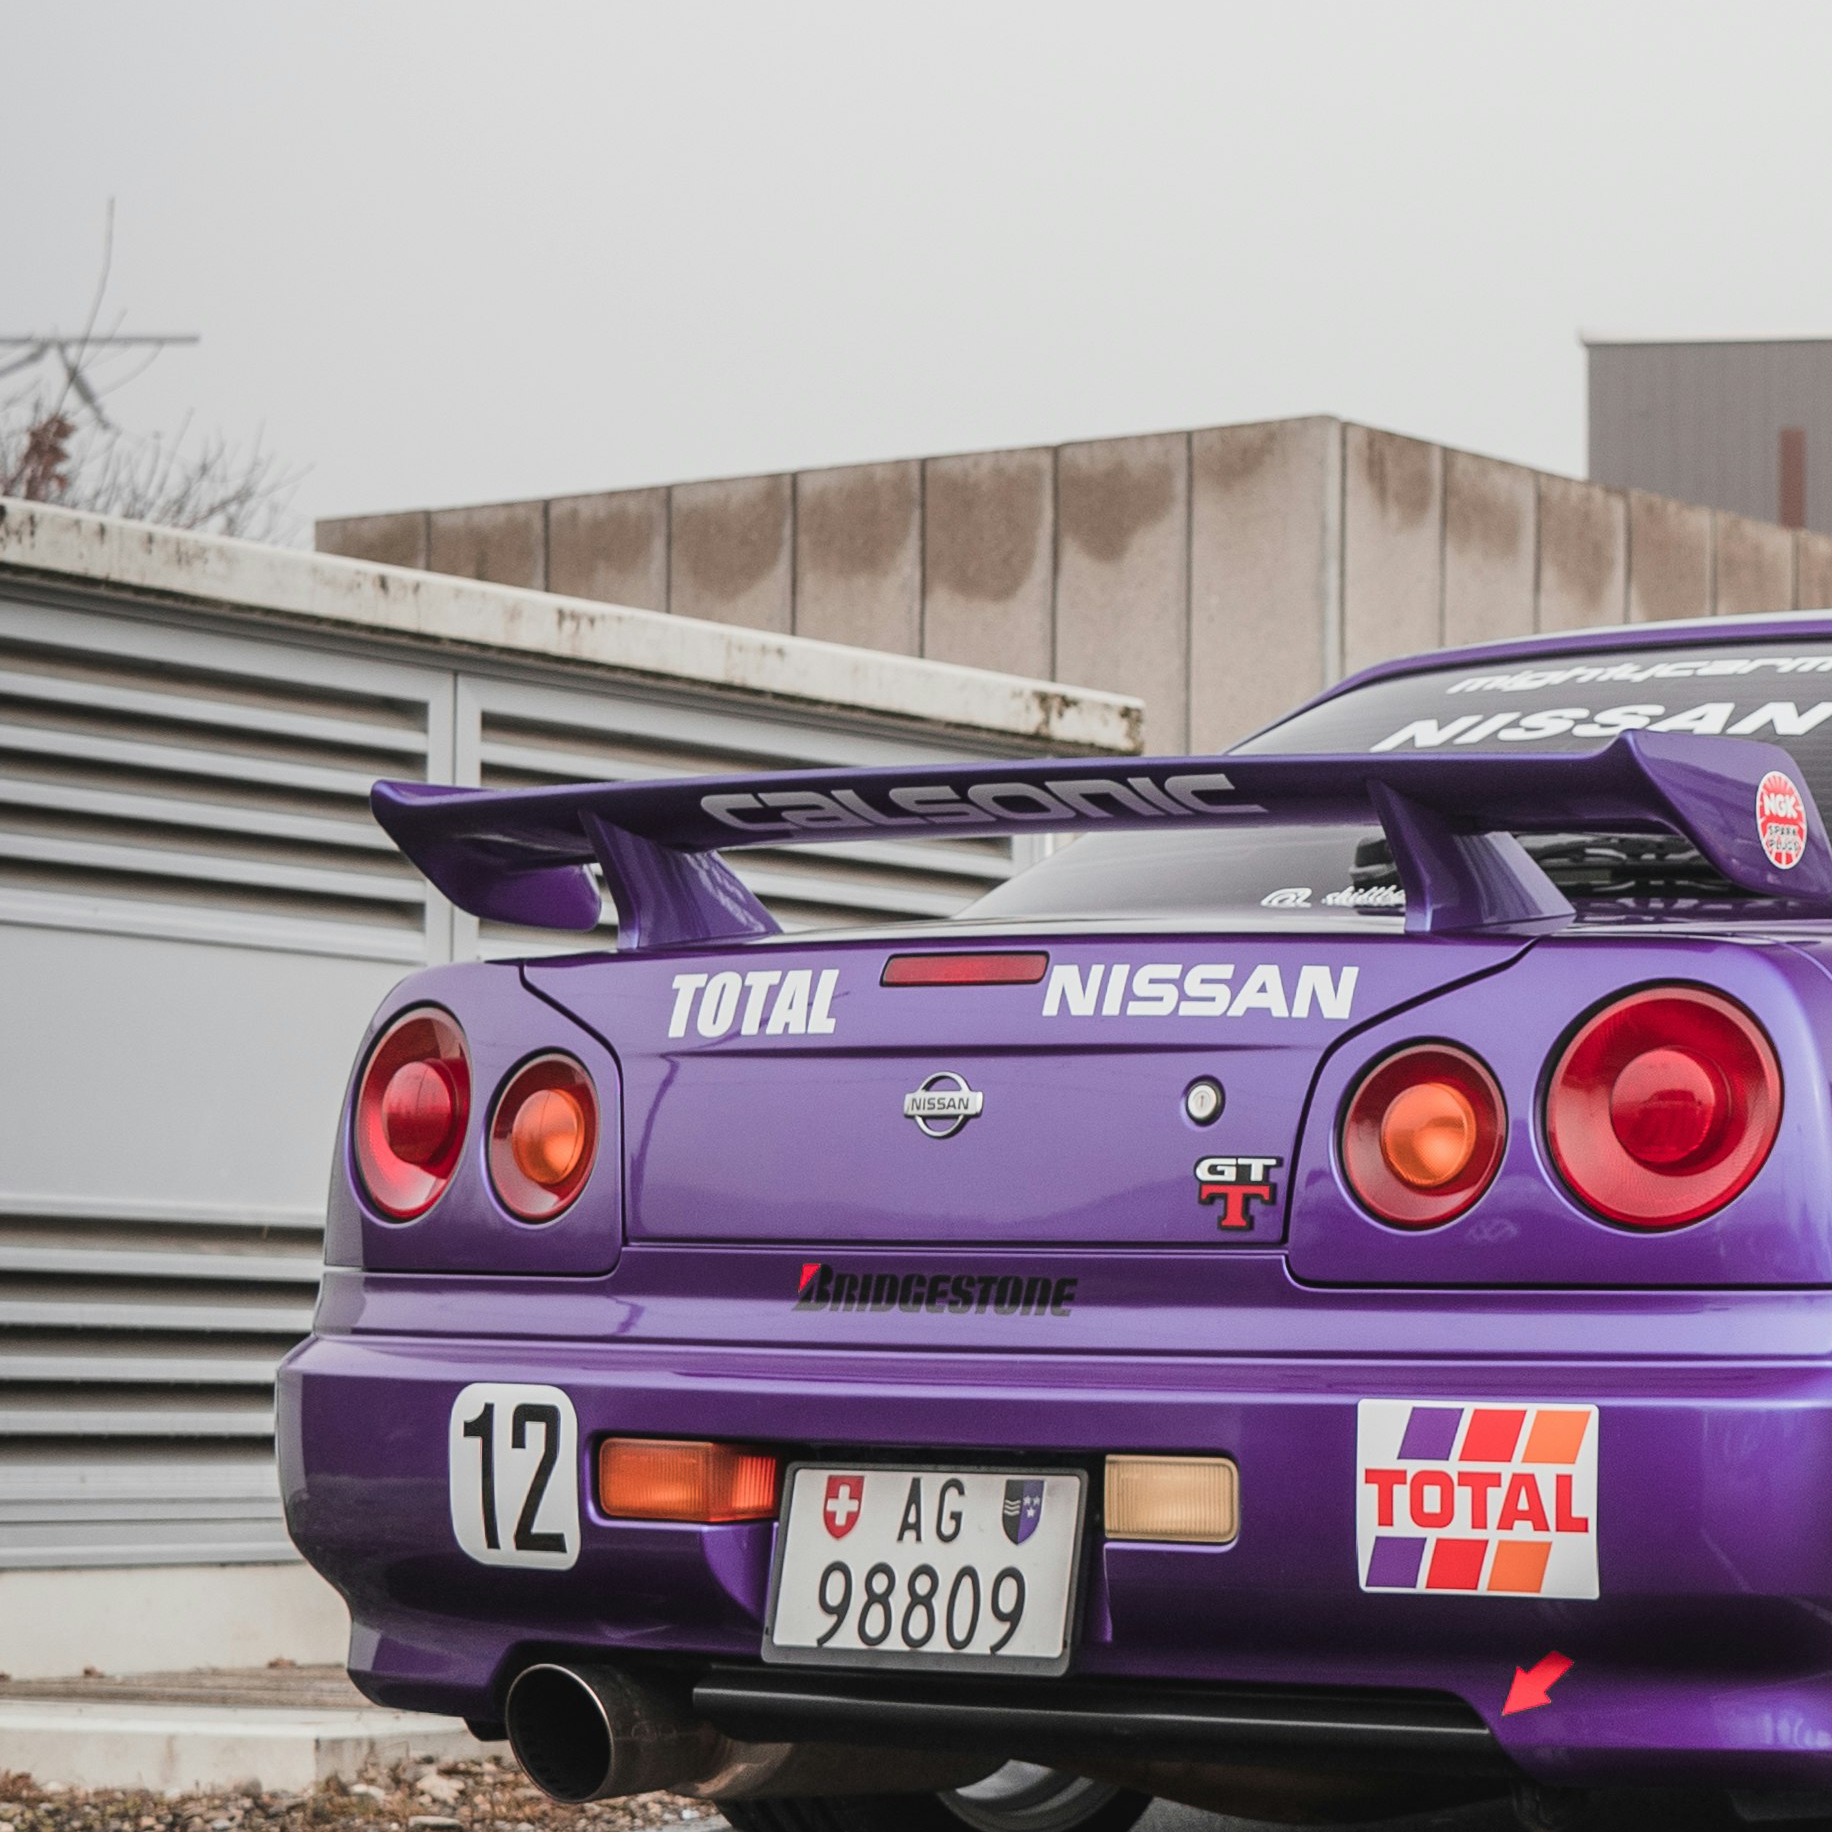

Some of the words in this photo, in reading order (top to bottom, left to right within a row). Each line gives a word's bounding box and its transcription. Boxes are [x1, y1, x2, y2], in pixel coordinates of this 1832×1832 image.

[1763, 793, 1799, 819] NGK
[667, 969, 839, 1039] TOTAL
[1042, 964, 1359, 1019] NISSAN
[911, 1097, 970, 1111] NISSAN
[1195, 1157, 1277, 1181] GT
[791, 1263, 1078, 1317] BRIDGESTONE
[462, 1401, 568, 1554] 12
[1364, 1468, 1590, 1534] TOTAL
[896, 1477, 967, 1543] AG
[816, 1561, 1027, 1657] 98809
